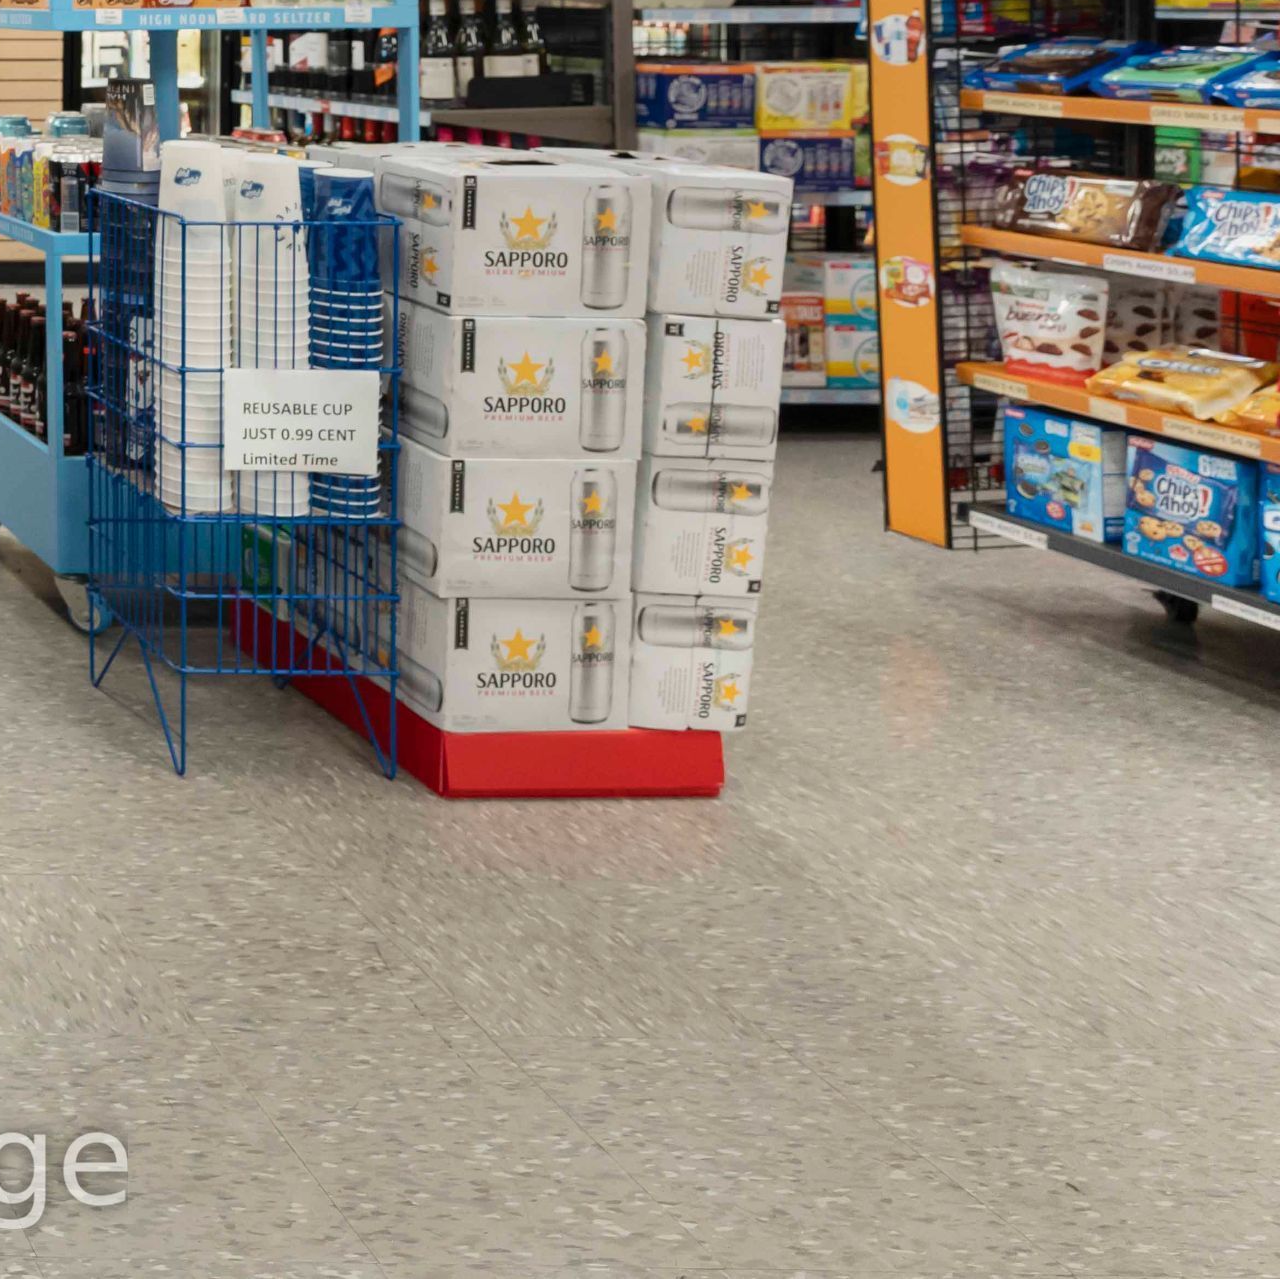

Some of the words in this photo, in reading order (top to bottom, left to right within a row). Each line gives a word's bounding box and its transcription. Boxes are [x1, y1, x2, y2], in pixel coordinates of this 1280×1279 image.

[139, 14, 172, 26] HIGH
[273, 12, 331, 24] SELTZER
[1027, 176, 1066, 197] Chips
[1215, 203, 1261, 222] Chips
[583, 236, 630, 246] SAPPORO
[484, 251, 568, 268] SAPPORO
[726, 246, 744, 303] SAPPORO
[582, 379, 625, 389] SAPPORO
[243, 402, 318, 416] REUSABLE
[322, 403, 353, 416] CUP
[484, 396, 566, 414] SAPPORO
[243, 427, 277, 441] JUST
[281, 428, 314, 441] 0.99
[317, 429, 357, 442] CENT
[242, 453, 297, 466] Limited
[302, 453, 338, 467] Time
[1156, 477, 1200, 500] Chips
[571, 519, 615, 530] SAPPORO
[472, 537, 555, 554] SAPPORO
[709, 527, 727, 584] SAPPORO
[477, 672, 556, 689] SAPPORO
[698, 662, 714, 719] SAPPORO
